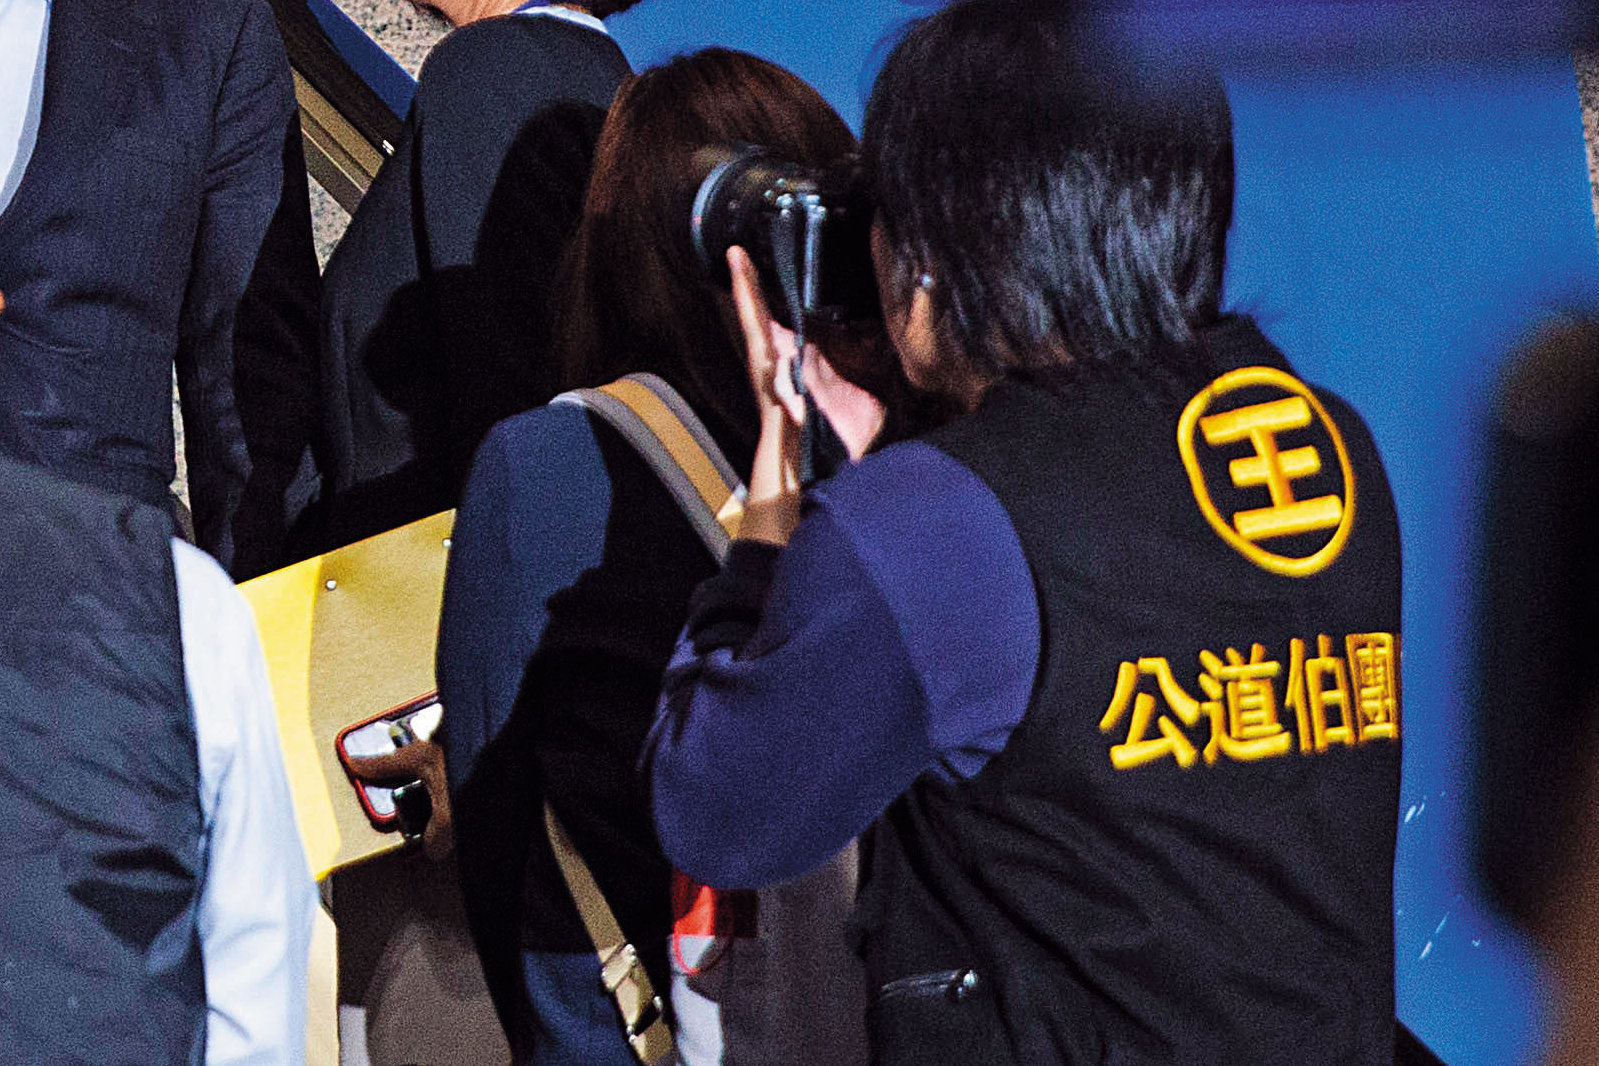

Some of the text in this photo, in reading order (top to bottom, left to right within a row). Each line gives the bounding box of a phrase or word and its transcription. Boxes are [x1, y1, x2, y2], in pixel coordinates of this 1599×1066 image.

[1201, 396, 1343, 540] 王
[1099, 632, 1400, 770] 公道伯團
